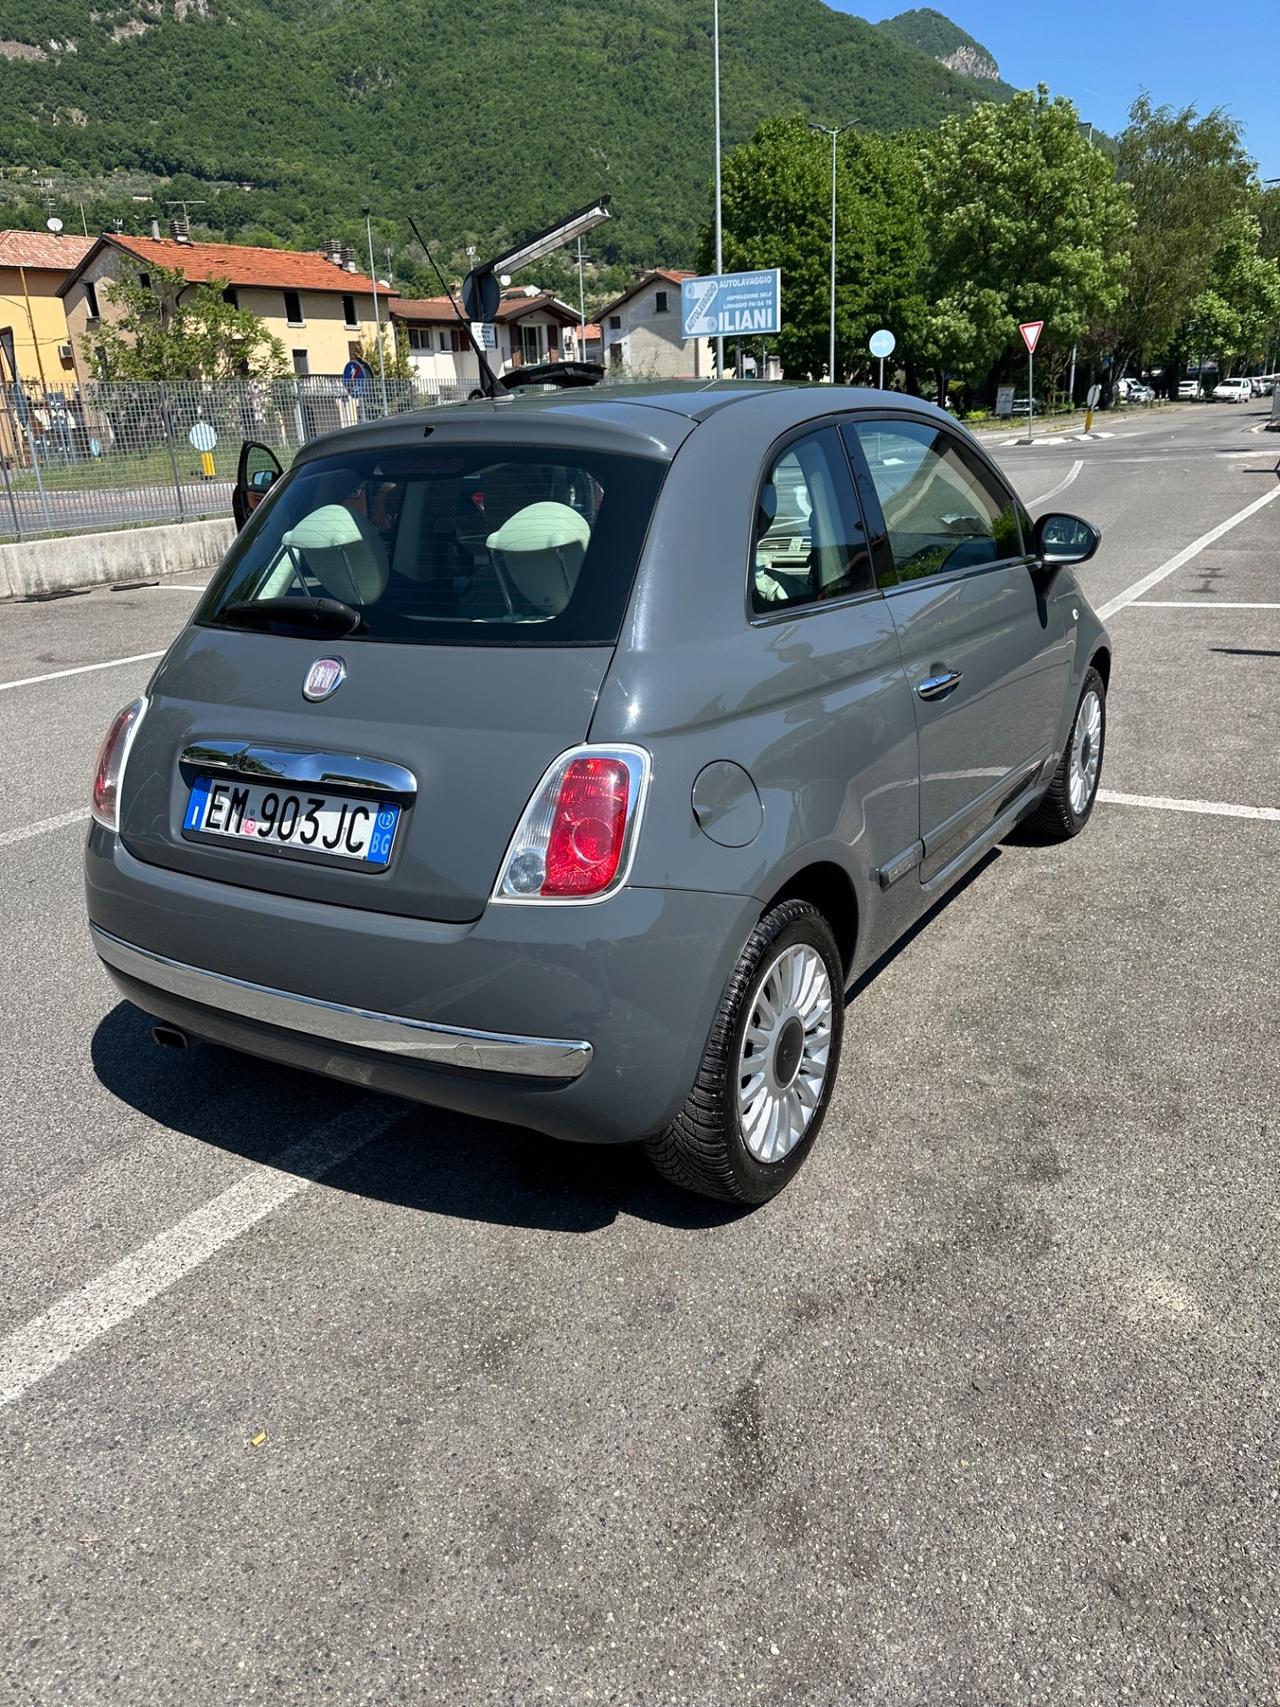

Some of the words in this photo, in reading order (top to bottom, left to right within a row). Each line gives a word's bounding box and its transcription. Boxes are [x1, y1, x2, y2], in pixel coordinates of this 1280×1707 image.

[720, 275, 772, 288] AUTOLAVAGGIO
[205, 784, 250, 834] EM
[371, 832, 391, 856] BG
